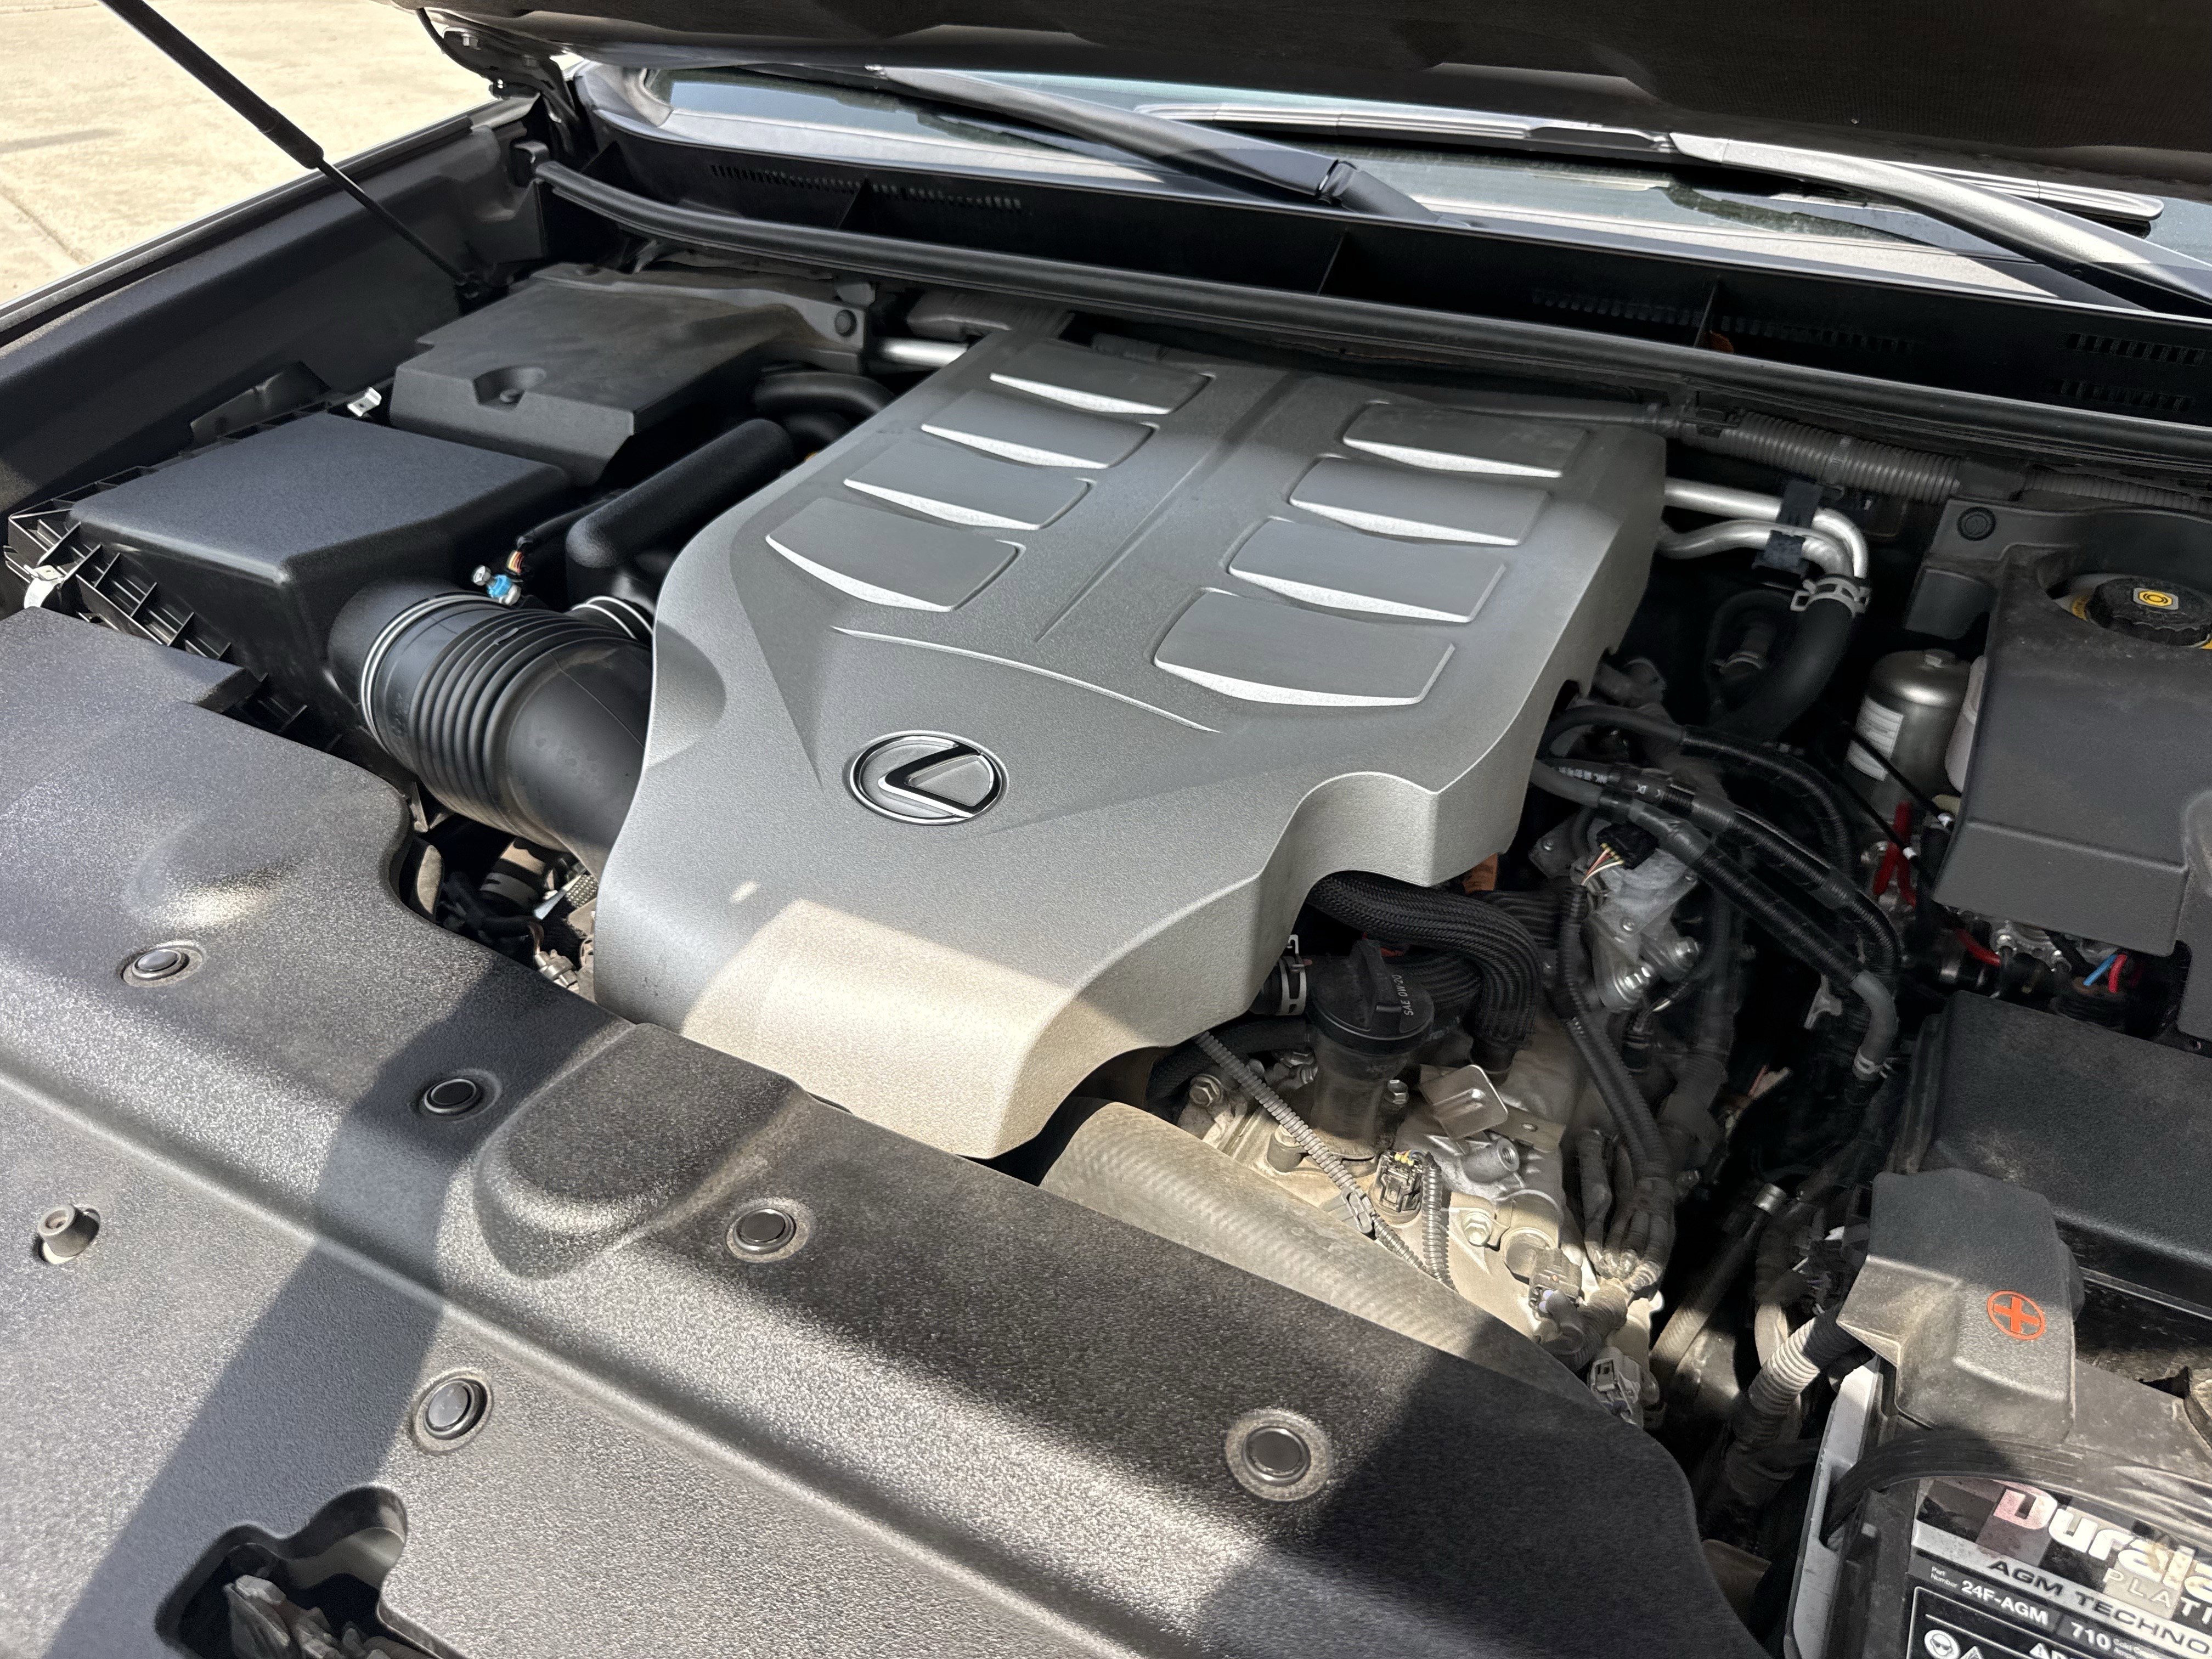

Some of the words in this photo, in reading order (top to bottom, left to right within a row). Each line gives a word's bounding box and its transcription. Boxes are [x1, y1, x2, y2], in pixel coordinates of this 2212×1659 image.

[1400, 1000, 1414, 1015] SAE
[1931, 1566, 1945, 1576] Part
[1931, 1573, 1958, 1588] Number
[1986, 1560, 2063, 1596] AGM
[2074, 1591, 2210, 1655] TECHNO
[1961, 1580, 2048, 1626] 24F-AGM
[2070, 1622, 2112, 1651] 710
